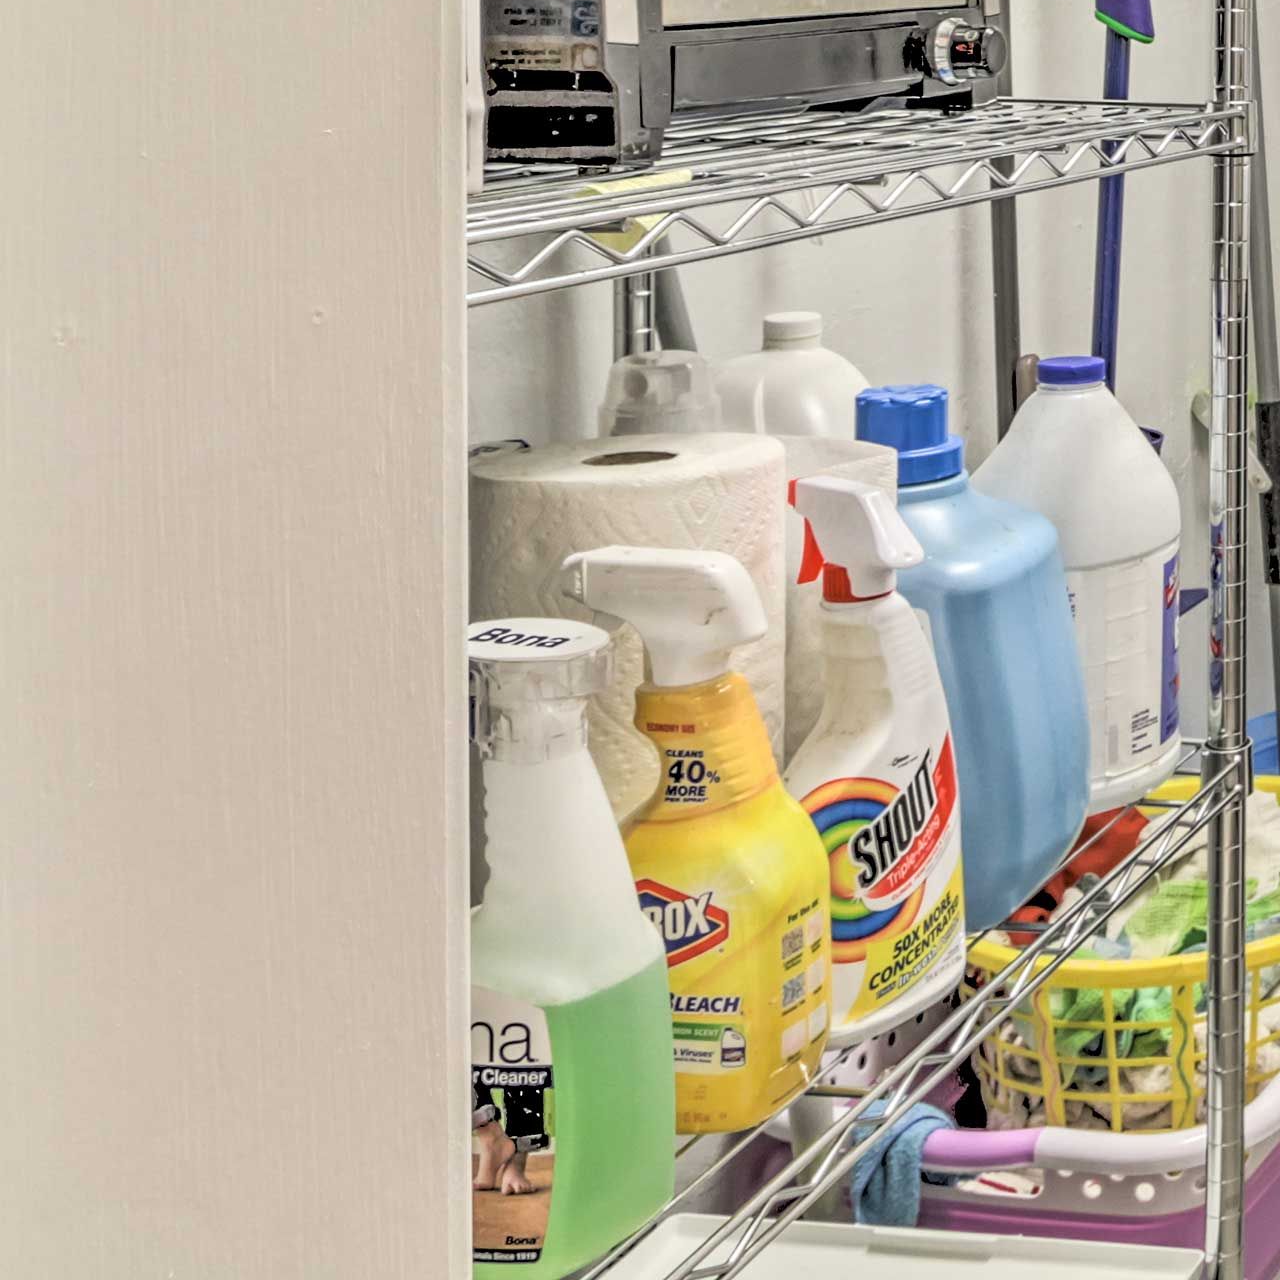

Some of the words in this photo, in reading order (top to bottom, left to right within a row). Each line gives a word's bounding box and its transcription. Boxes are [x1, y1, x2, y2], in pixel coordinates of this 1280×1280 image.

[468, 628, 571, 648] Bona
[664, 749, 704, 759] CLEANS
[668, 759, 721, 784] 40%
[664, 785, 707, 797] MORE
[852, 748, 935, 888] SHOUT
[643, 891, 713, 941] ROX
[923, 890, 951, 934] MORE
[869, 895, 959, 990] CONCENTRATED
[471, 1021, 535, 1064] na
[481, 1068, 547, 1086] Cleaner
[505, 1236, 538, 1246] Bona
